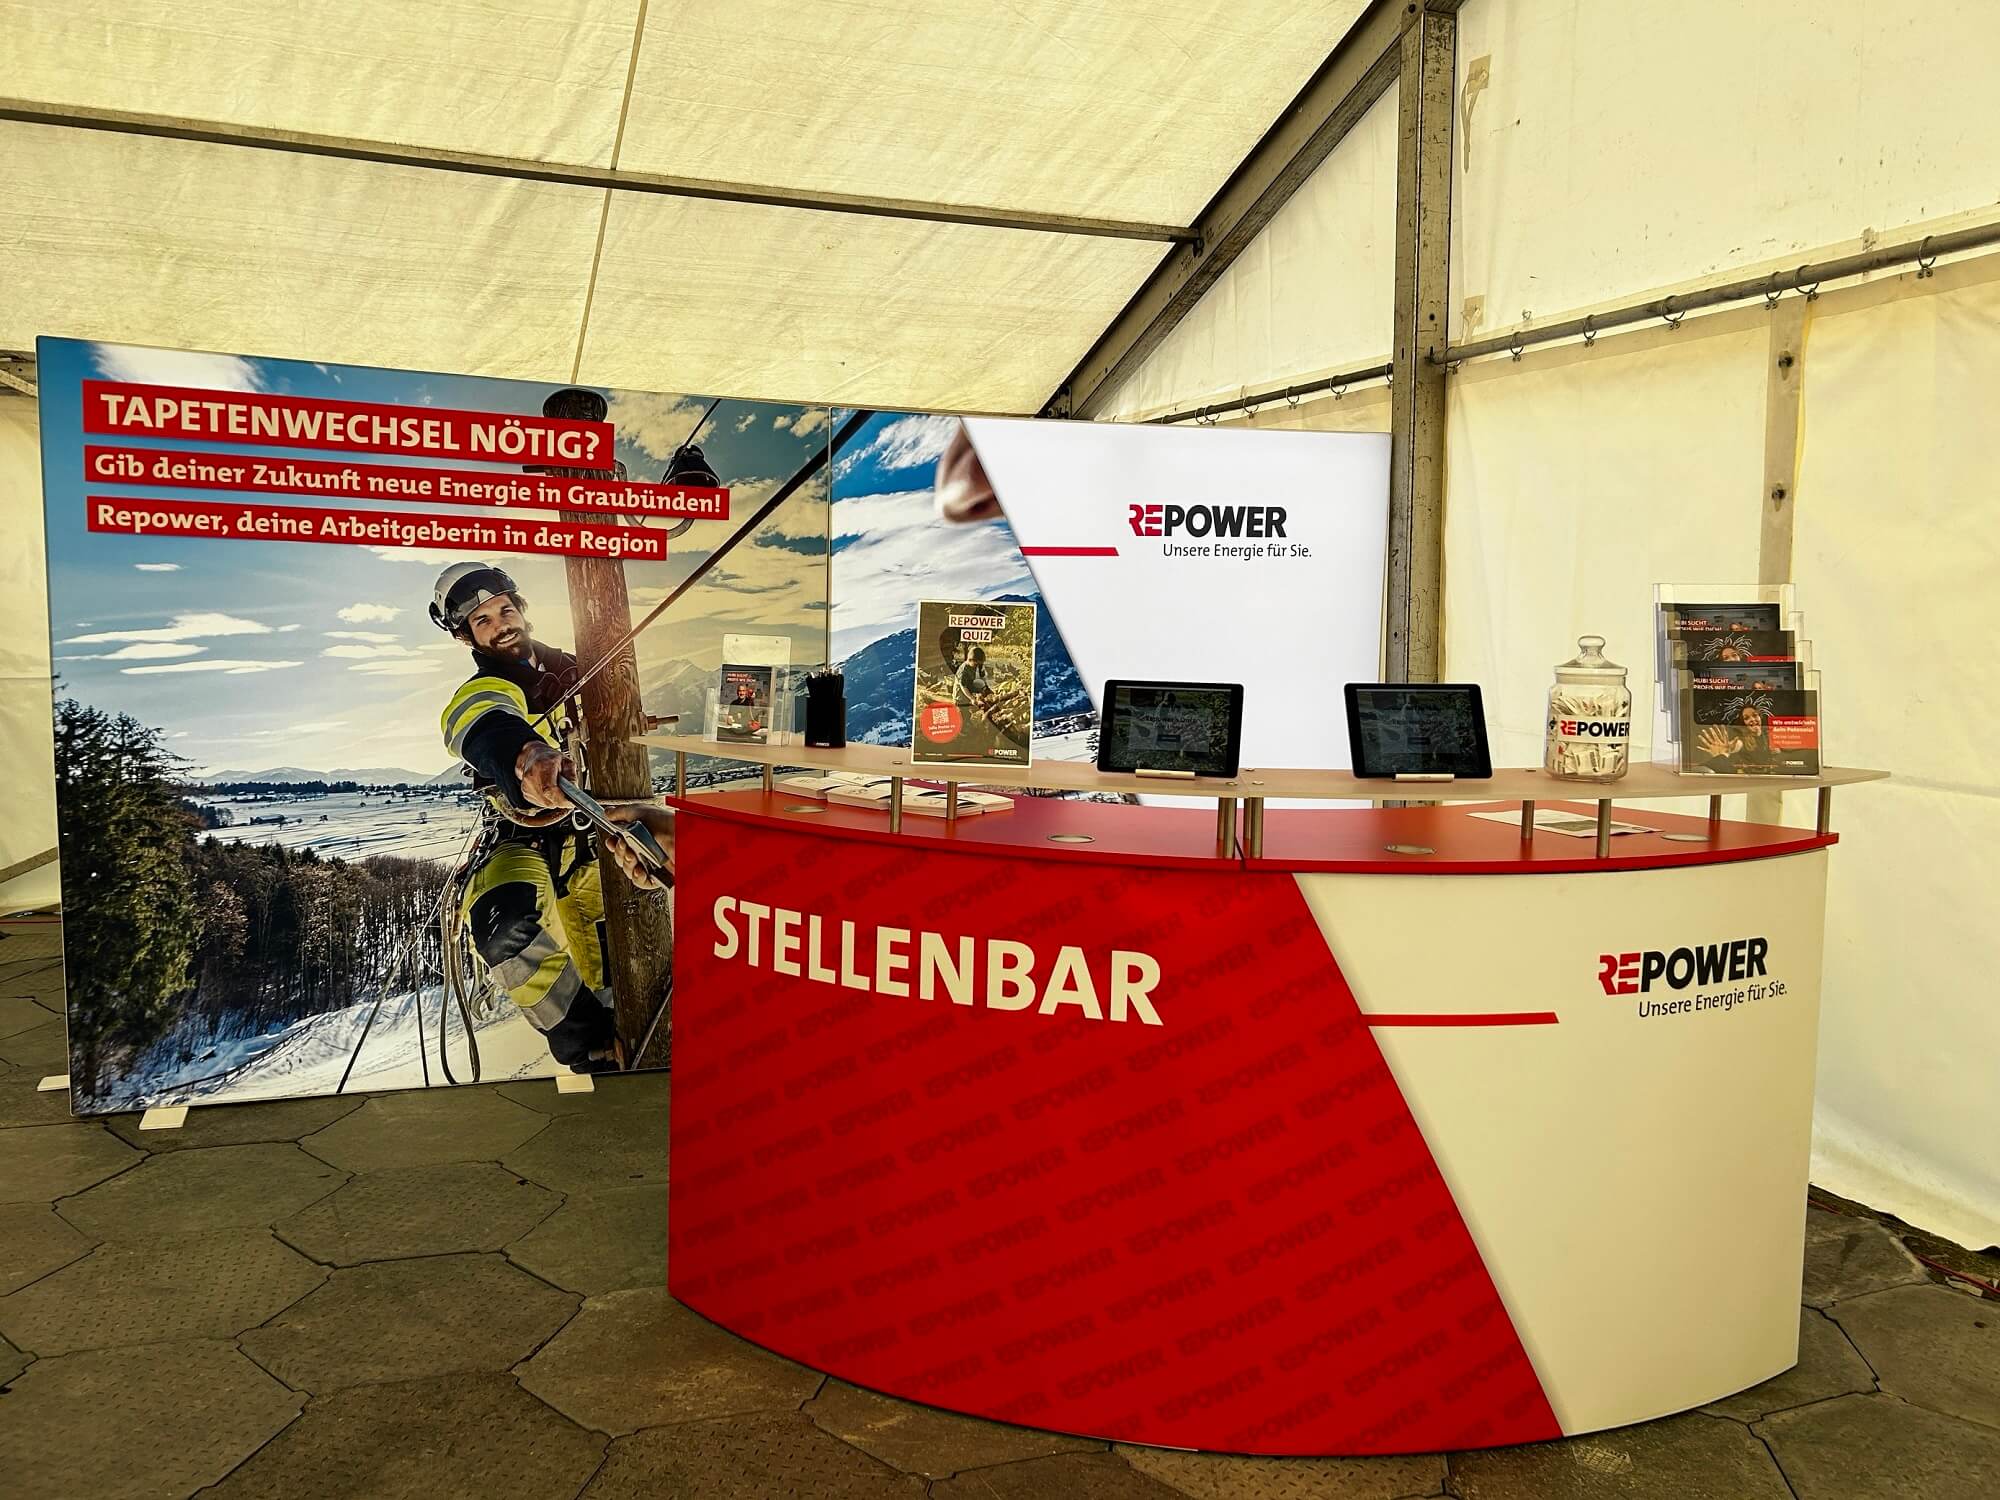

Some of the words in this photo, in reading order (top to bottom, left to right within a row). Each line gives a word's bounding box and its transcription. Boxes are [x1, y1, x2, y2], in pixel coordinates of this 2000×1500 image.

[100, 393, 460, 450] TAPETENWECHSEL
[470, 419, 600, 461] NÖTIG?
[95, 454, 145, 477] Gib
[152, 457, 245, 484] deiner
[252, 464, 361, 491] Zukunft
[367, 476, 432, 494] neue
[439, 477, 531, 506] Energie
[538, 482, 561, 503] in
[568, 486, 721, 513] Graubünden!
[97, 504, 229, 535] Repower,
[236, 511, 313, 535] deine
[320, 516, 496, 546] Arbeitgeberin
[503, 525, 527, 545] in
[533, 527, 574, 548] der
[580, 531, 658, 553] Region
[1129, 504, 1287, 538] REPOWER
[1163, 544, 1210, 557] Unsere
[1214, 544, 1264, 561] Energie
[1267, 544, 1287, 557] für
[1290, 544, 1312, 558] Sie.
[950, 616, 1004, 628] REPOWER
[962, 630, 991, 642] QUIZ
[1560, 719, 1630, 737] REPOWER
[713, 895, 1165, 1026] STELLENBAR
[1598, 937, 1768, 996] REPOWER
[1639, 999, 1692, 1018] Unsere
[1695, 988, 1744, 1011] Energie
[1747, 983, 1767, 1002] für
[1768, 980, 1788, 998] Sie.
